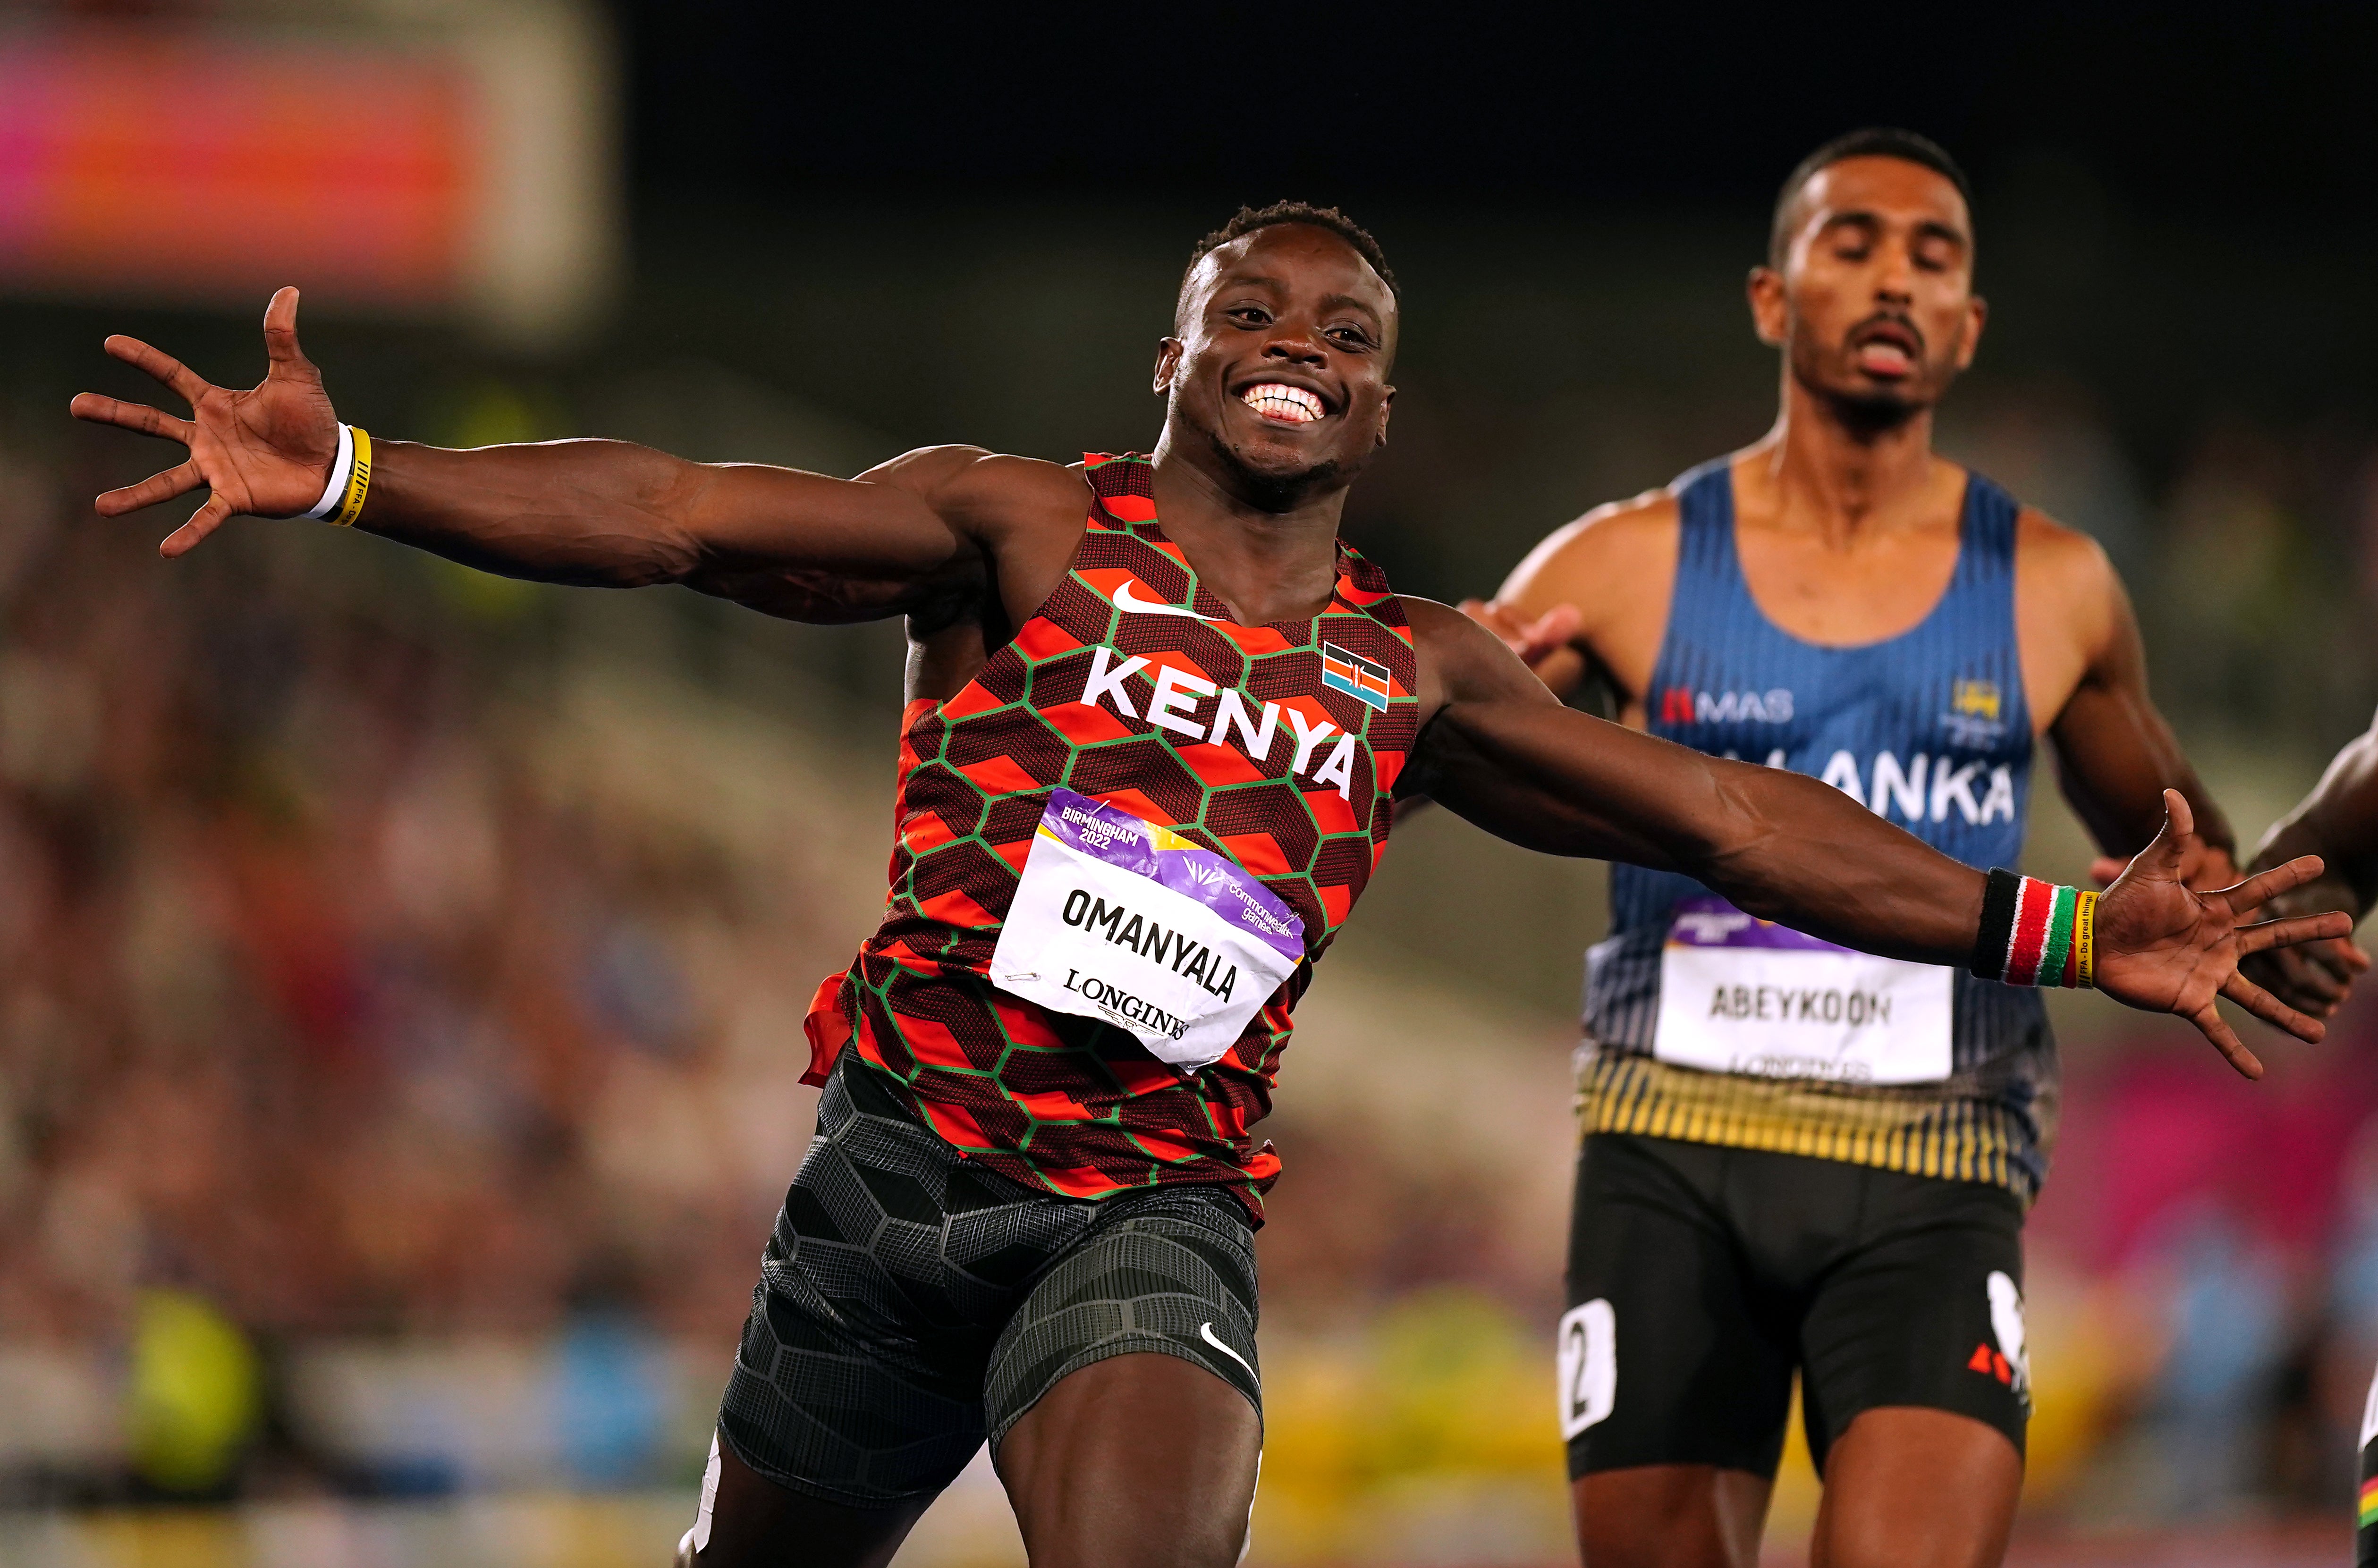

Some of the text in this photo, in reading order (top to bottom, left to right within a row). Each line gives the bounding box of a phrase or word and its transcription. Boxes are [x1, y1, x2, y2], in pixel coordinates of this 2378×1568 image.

[346, 510, 356, 519] Do
[353, 489, 364, 504] FFA
[1080, 645, 1356, 801] KENYA
[1695, 688, 1794, 724] MAS
[1061, 806, 1139, 847] BIRMINGHAM
[1078, 828, 1111, 850] 2022
[1228, 883, 1294, 939] commonwealth
[1241, 907, 1273, 935] games
[1063, 889, 1237, 1003] OMANYALA
[2081, 942, 2088, 953] Do
[2080, 960, 2088, 974] FFA
[1709, 984, 1893, 1028] ABEYKOON
[1567, 1321, 1587, 1419] 2
